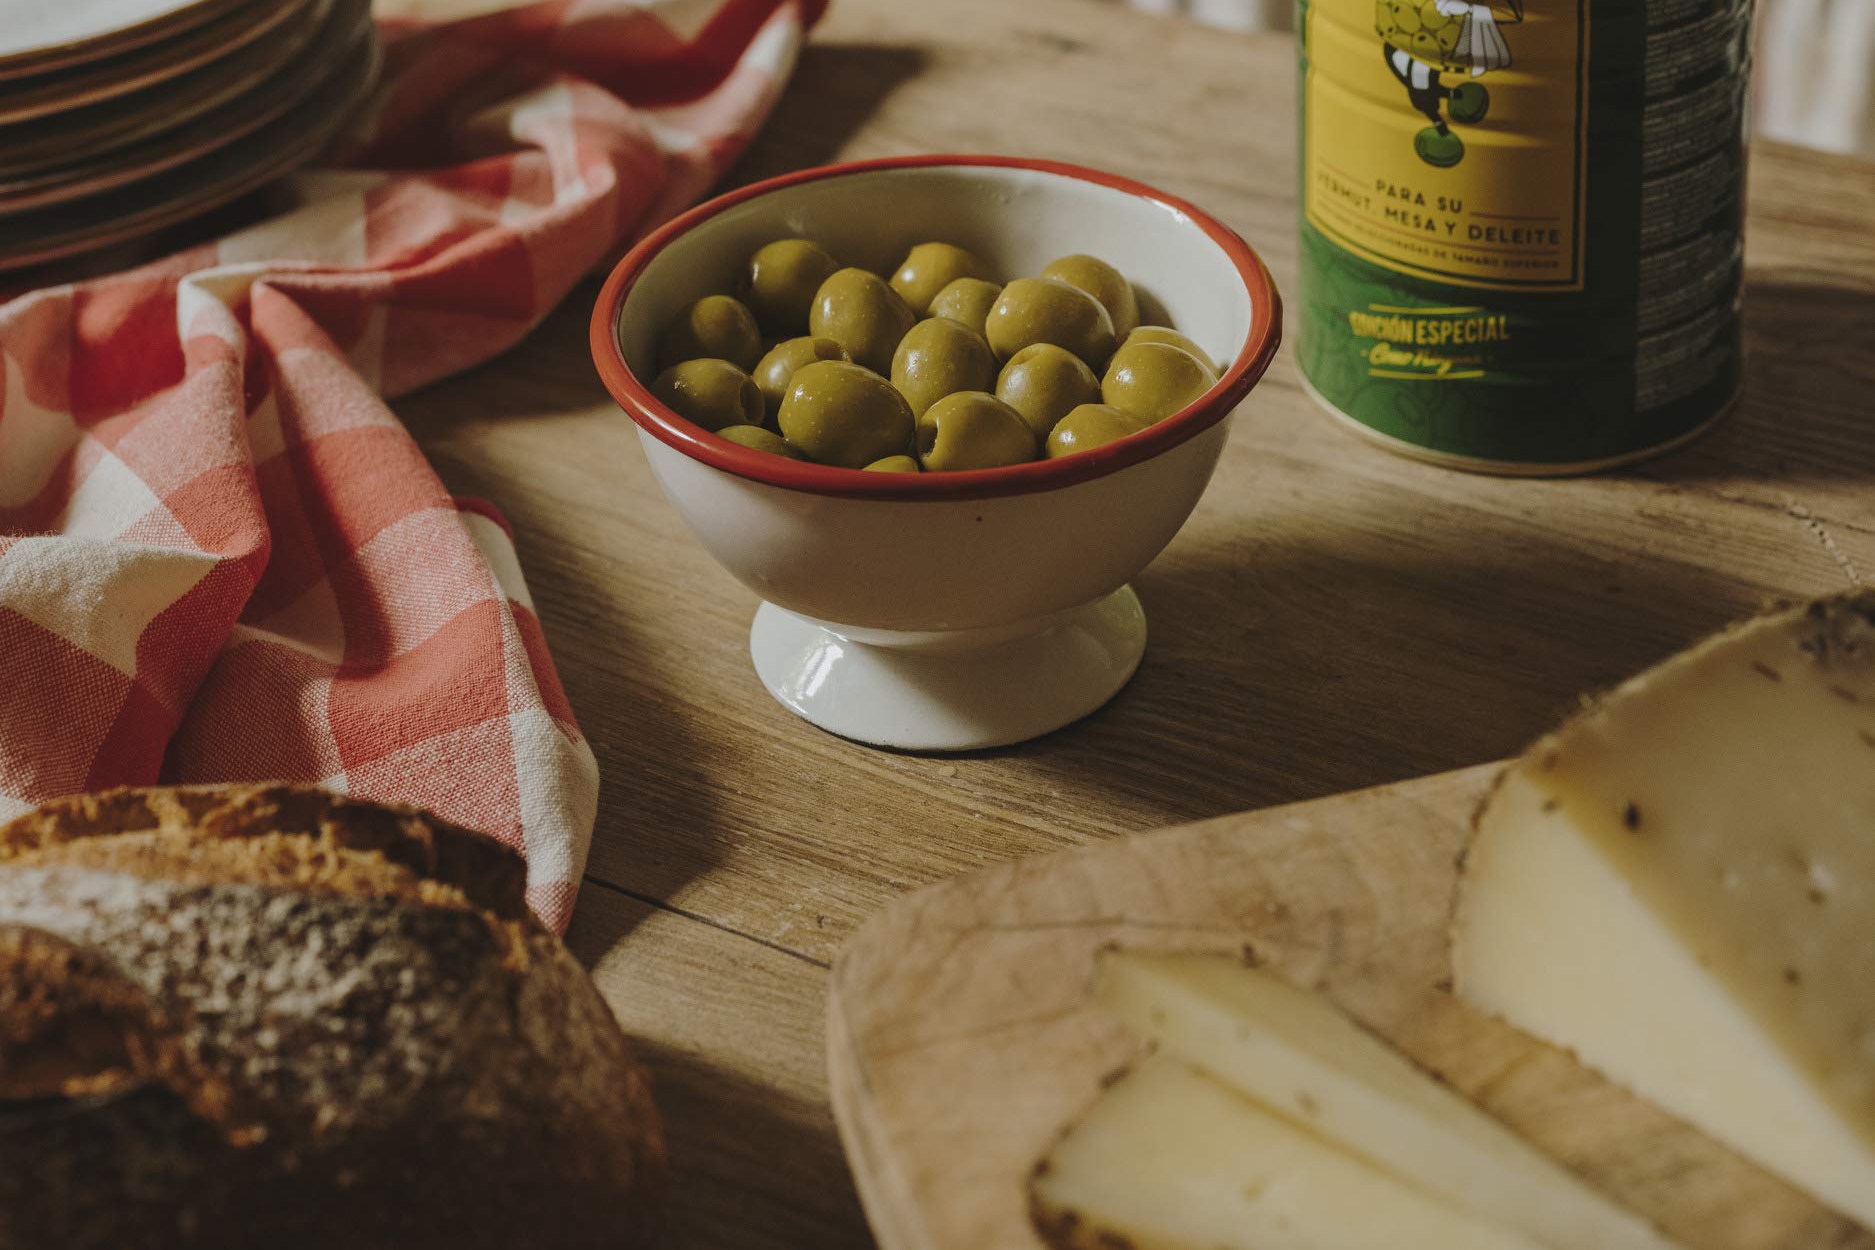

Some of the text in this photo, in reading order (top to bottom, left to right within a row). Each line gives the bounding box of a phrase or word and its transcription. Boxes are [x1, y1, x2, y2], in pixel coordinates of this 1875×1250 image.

[1376, 179, 1462, 214] PARA SU
[1384, 206, 1436, 232] MESA
[1445, 220, 1456, 236] Y
[1468, 224, 1560, 244] DELEITE
[1415, 315, 1510, 345] ESPECIAL
